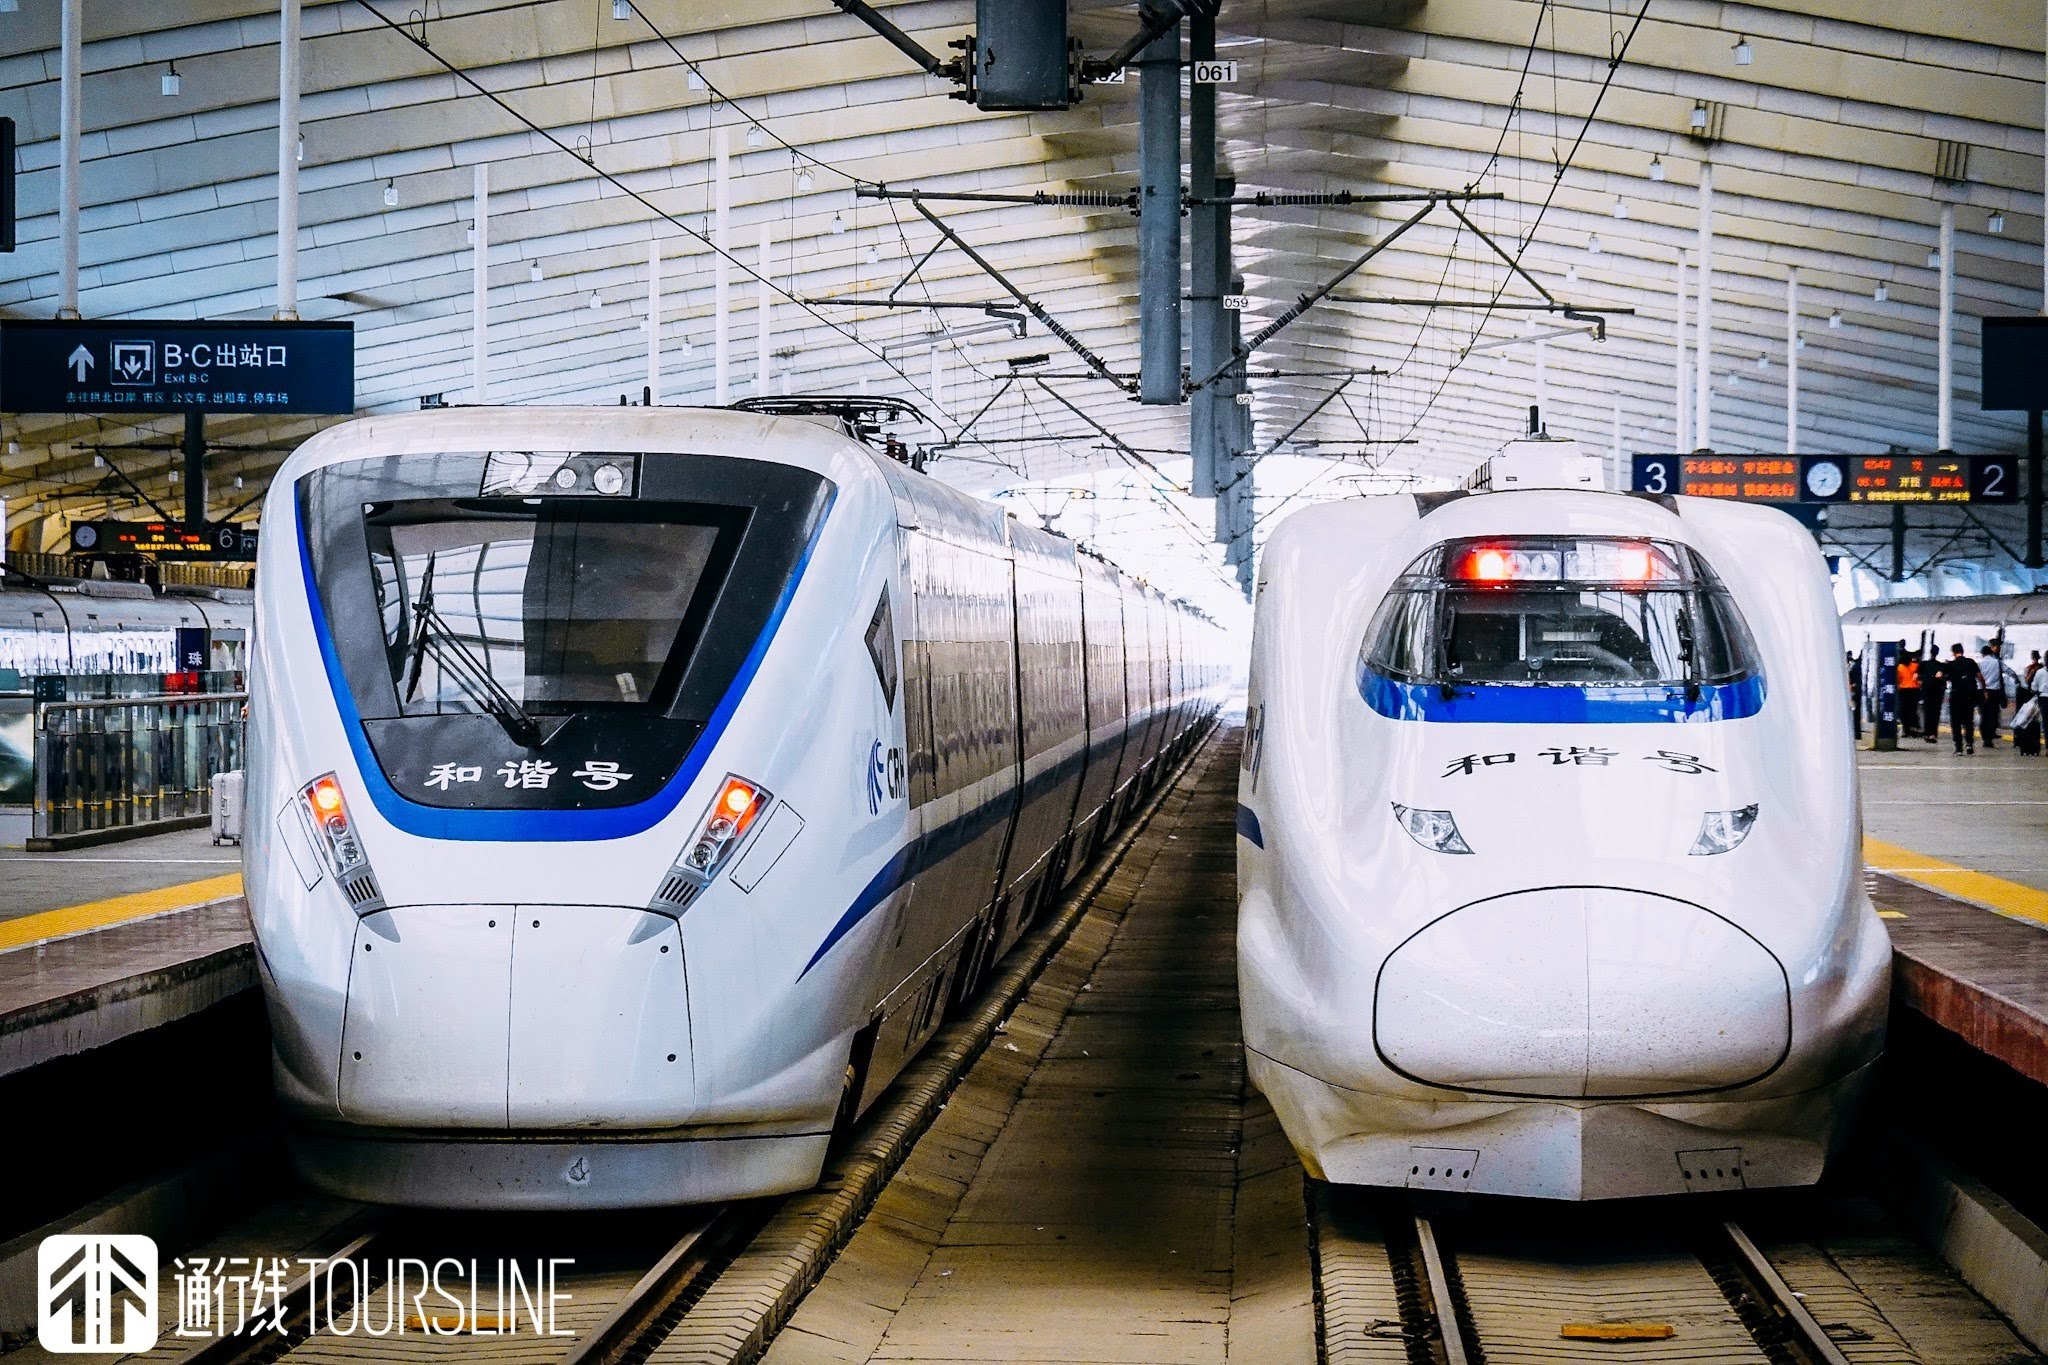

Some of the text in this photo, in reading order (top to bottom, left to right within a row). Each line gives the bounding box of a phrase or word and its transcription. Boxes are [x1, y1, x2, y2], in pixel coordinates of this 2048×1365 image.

[1197, 65, 1233, 81] 061
[1224, 298, 1248, 308] 059
[164, 373, 186, 383] Exit
[1645, 463, 1667, 494] 3
[1982, 464, 2005, 496] 2
[219, 528, 233, 548] 6
[188, 651, 202, 666] 珠
[1440, 746, 1719, 778] 和谐号
[423, 759, 633, 791] 和谐号
